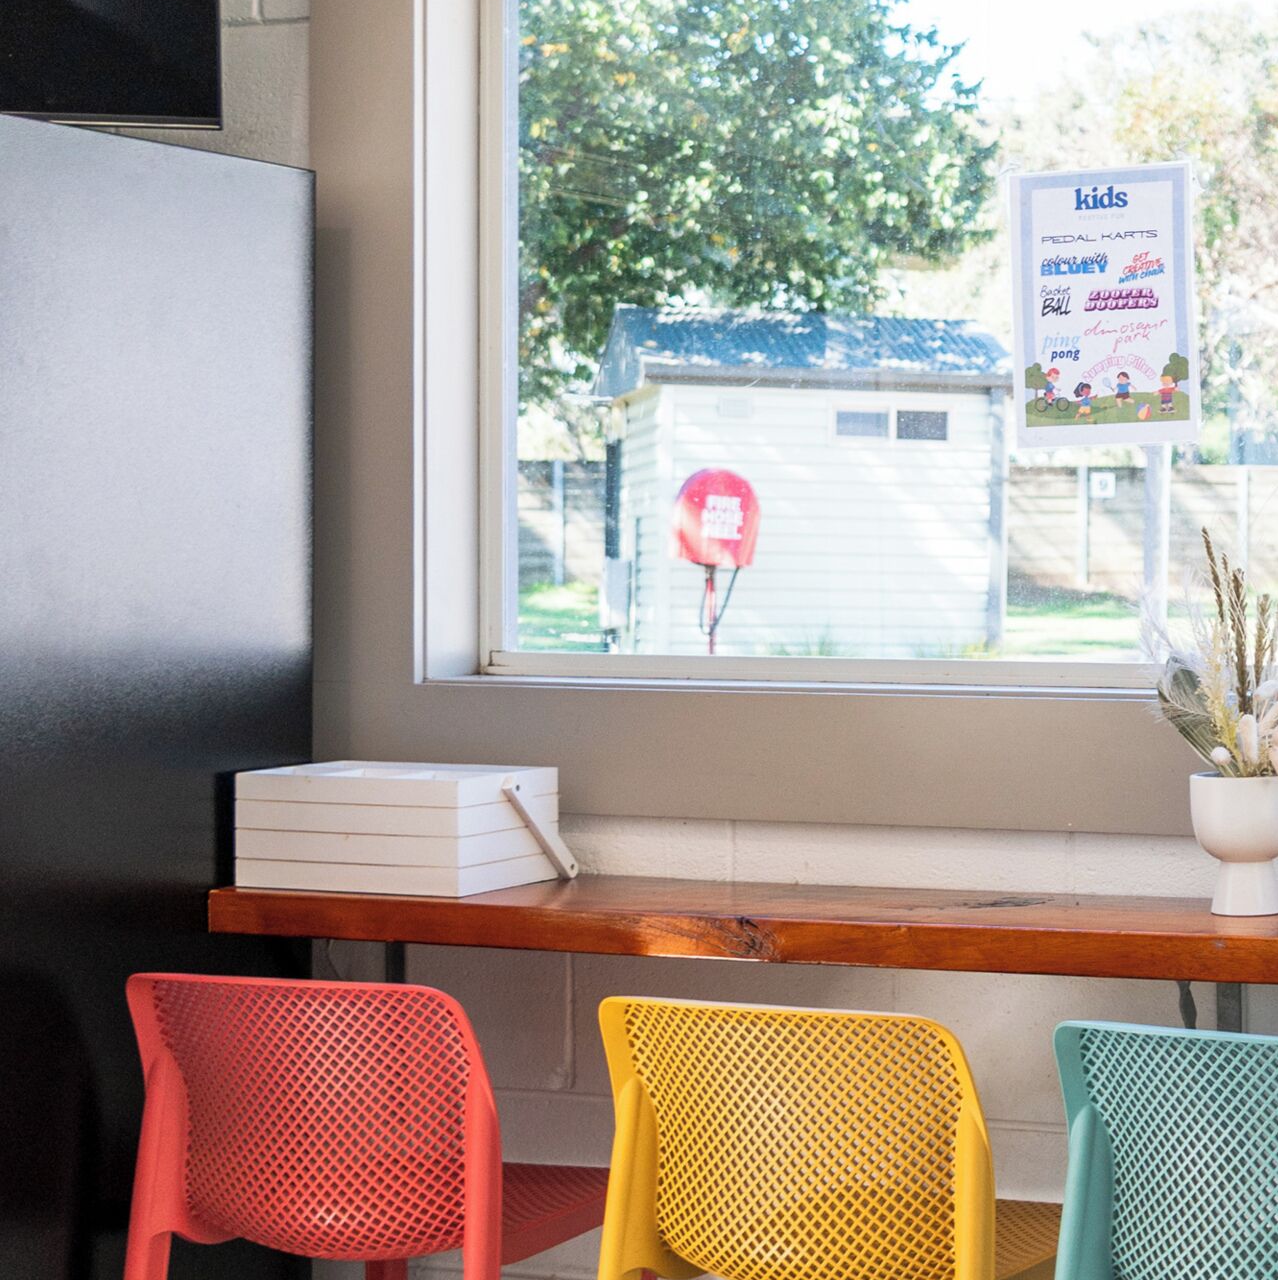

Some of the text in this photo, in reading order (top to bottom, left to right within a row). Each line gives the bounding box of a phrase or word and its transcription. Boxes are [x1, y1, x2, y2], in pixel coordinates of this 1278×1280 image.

[1074, 185, 1128, 210] kids
[1041, 229, 1158, 244] PEDAL KARTS
[1041, 252, 1108, 267] colour with
[1132, 251, 1150, 264] GET
[1040, 261, 1108, 276] BLUEY
[1122, 257, 1163, 275] CREATIVE
[1040, 285, 1071, 298] Basket
[1088, 288, 1154, 300] ZOOPER
[1041, 296, 1071, 317] BALL
[1084, 298, 1159, 312] DOOPERS
[1084, 319, 1168, 337] dinosaur
[1042, 332, 1081, 354] ping
[1112, 331, 1150, 353] park
[1051, 349, 1081, 362] pong
